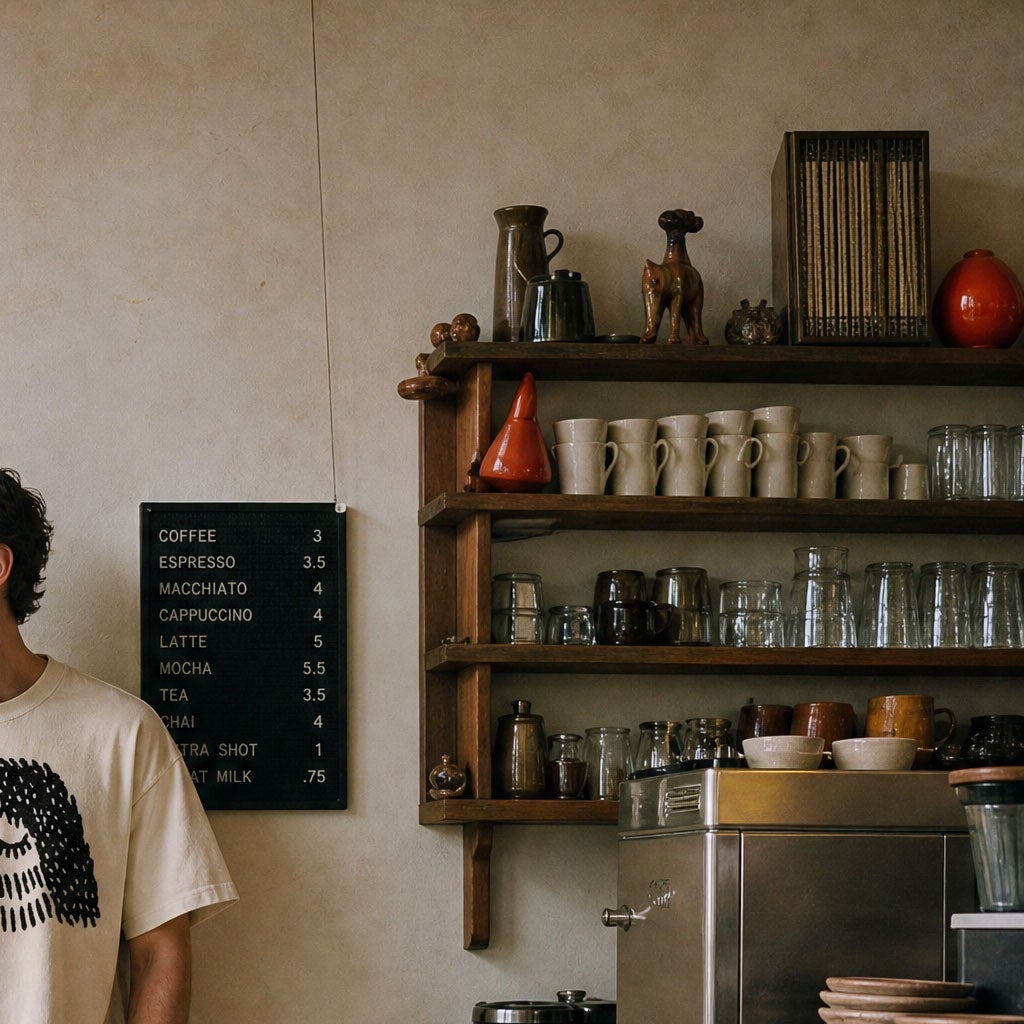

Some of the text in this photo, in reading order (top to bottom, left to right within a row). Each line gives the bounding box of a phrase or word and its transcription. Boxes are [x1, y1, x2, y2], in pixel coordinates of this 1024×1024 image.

[158, 528, 322, 543] COFFEE 3
[159, 555, 326, 569] ESPRESSO 3.5
[159, 581, 323, 596] MACCHIATO 4
[159, 607, 323, 622] CAPPUCCINO 4
[159, 634, 323, 649] LATTE 5
[159, 661, 326, 676] MOCHA 5.5
[159, 687, 326, 702] TEA 3.5
[160, 714, 324, 729] CHAI 4
[177, 742, 323, 757] TRA SHOT 1
[190, 769, 326, 784] AT MILK .75
